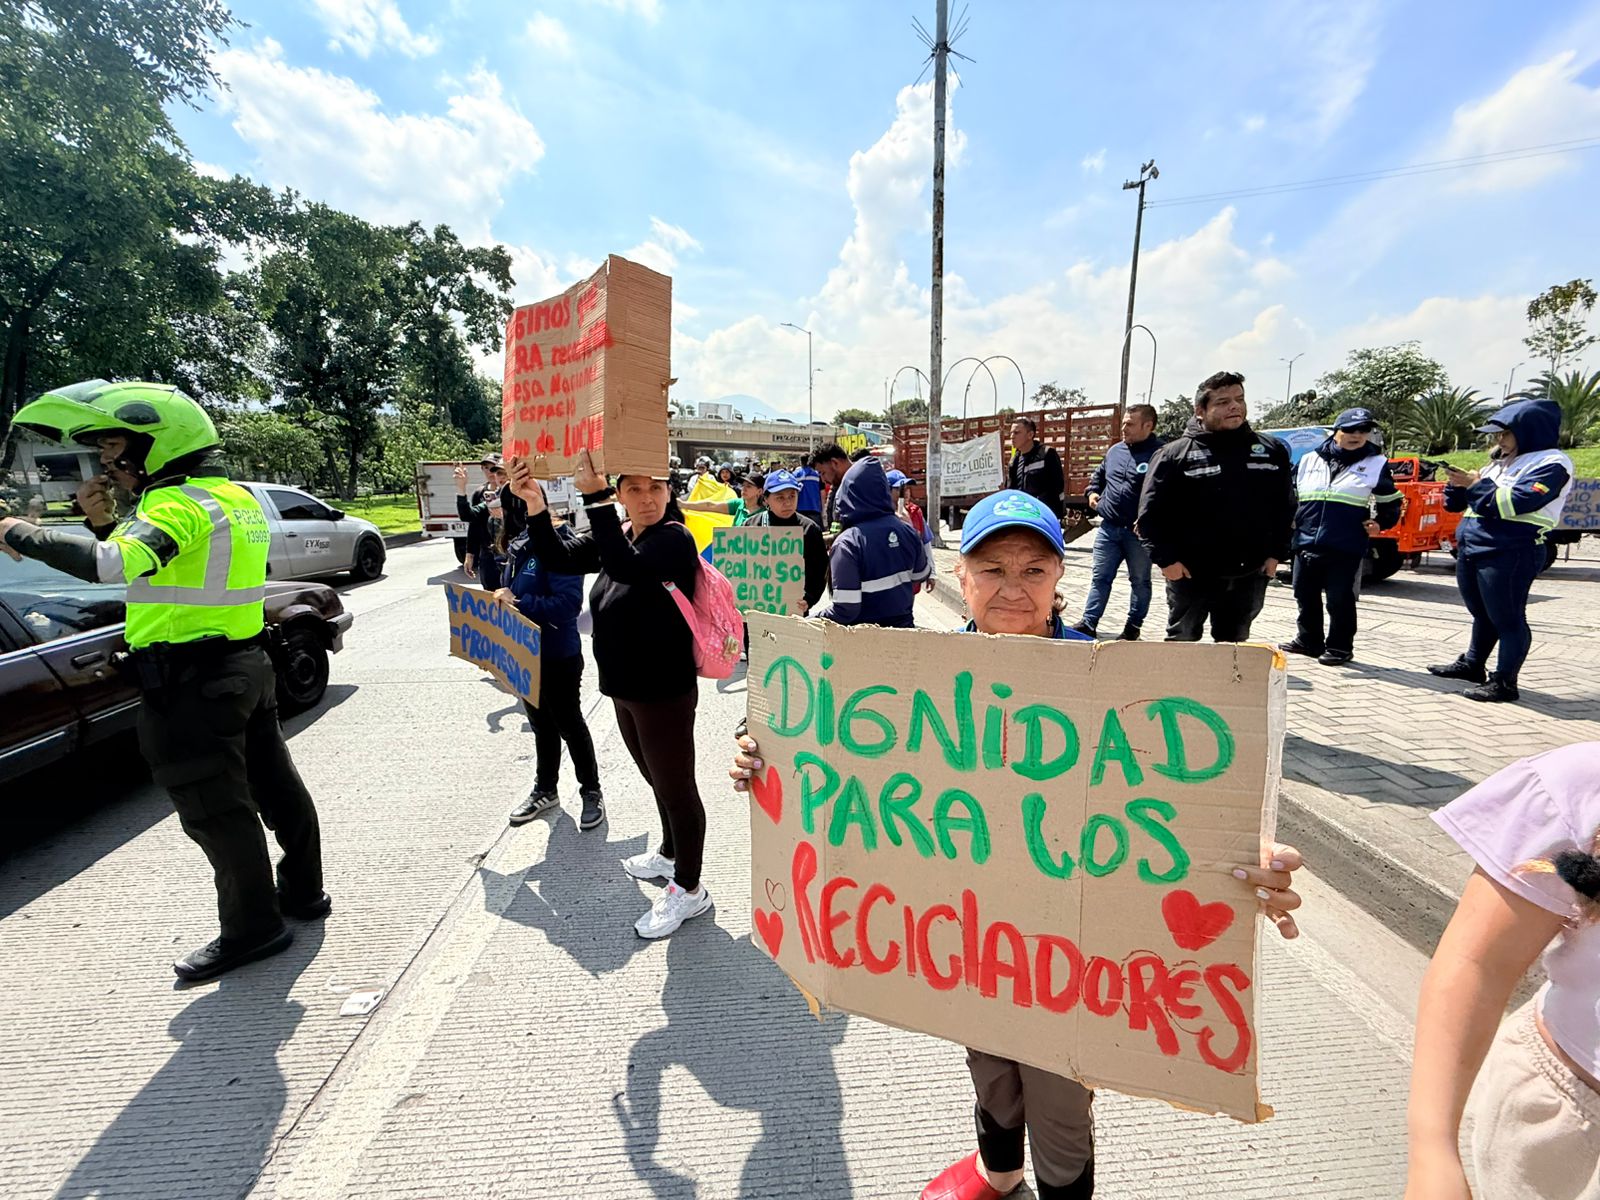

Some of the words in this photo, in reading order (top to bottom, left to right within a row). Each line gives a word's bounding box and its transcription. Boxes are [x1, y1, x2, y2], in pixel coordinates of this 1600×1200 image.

[946, 462, 961, 475] ECO
[713, 531, 804, 556] Inclusión
[753, 562, 771, 580] no
[736, 582, 758, 600] en
[762, 583, 783, 604] el
[793, 751, 992, 865] PARA
